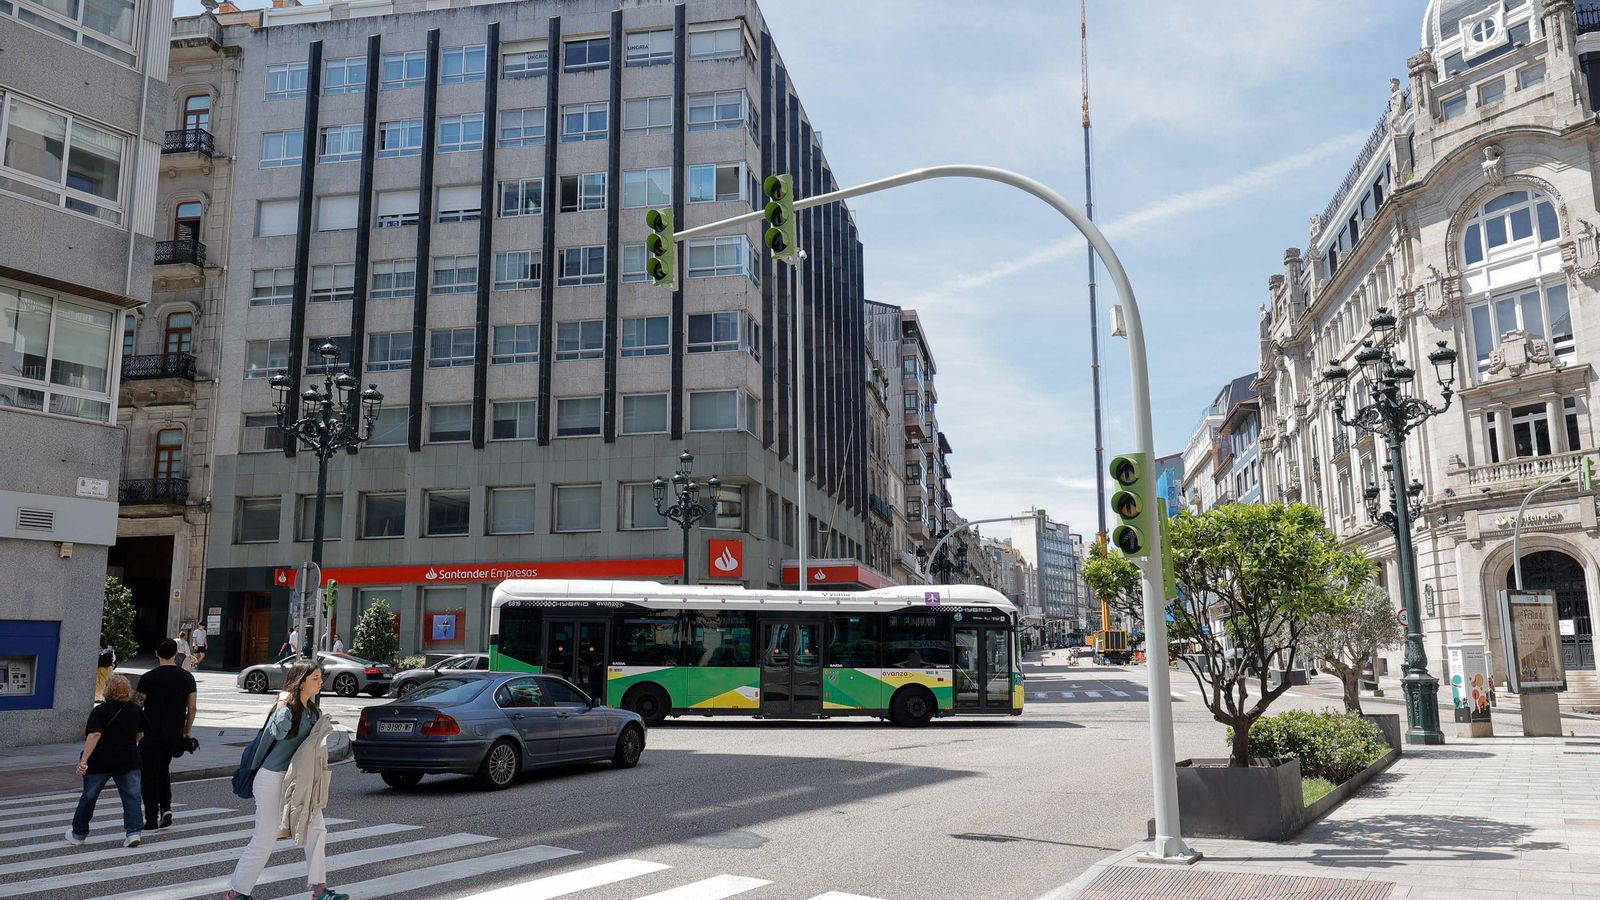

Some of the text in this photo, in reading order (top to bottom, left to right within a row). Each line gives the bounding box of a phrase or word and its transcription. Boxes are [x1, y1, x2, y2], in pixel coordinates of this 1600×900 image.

[1508, 511, 1560, 524] Santander
[439, 568, 538, 580] Santander Empresas
